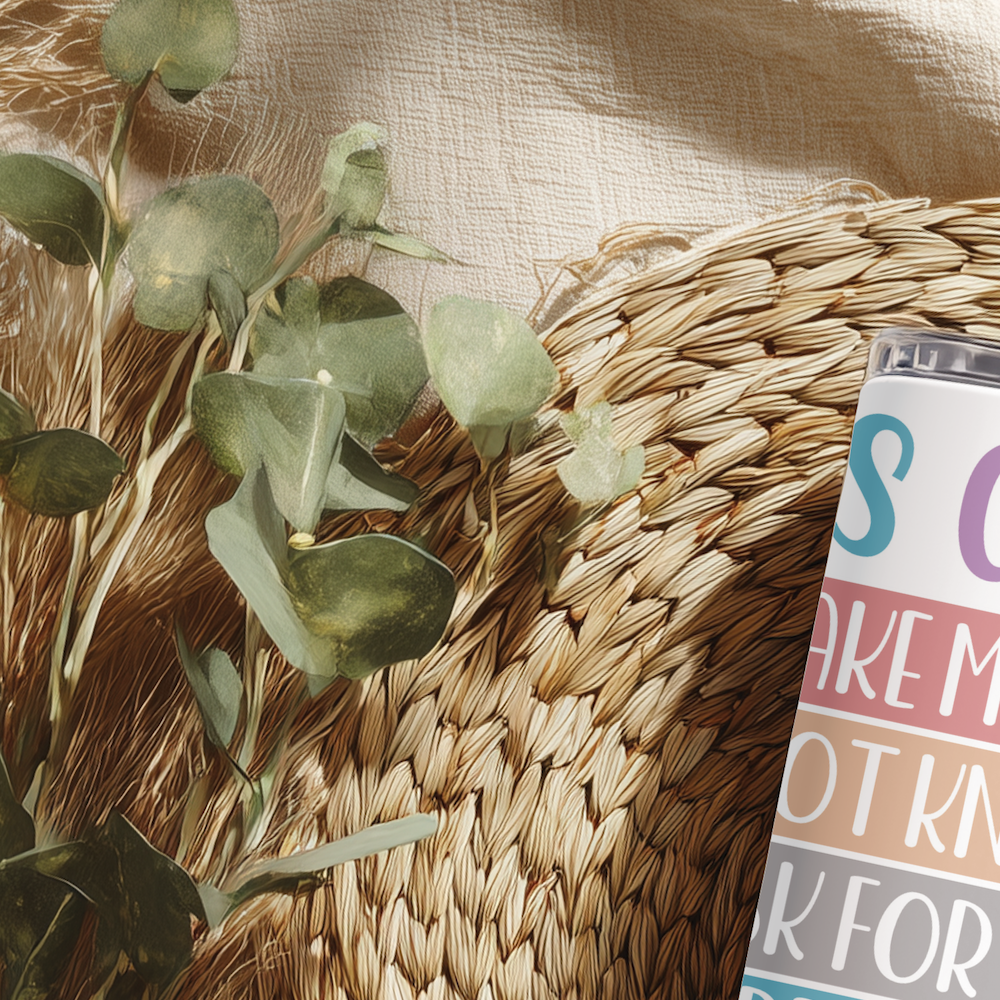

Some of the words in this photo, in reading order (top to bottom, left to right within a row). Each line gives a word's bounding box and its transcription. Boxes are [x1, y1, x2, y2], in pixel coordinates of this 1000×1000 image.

[833, 413, 915, 557] S
[775, 731, 901, 837] OT
[750, 861, 826, 961] K
[831, 875, 993, 998] FOR
